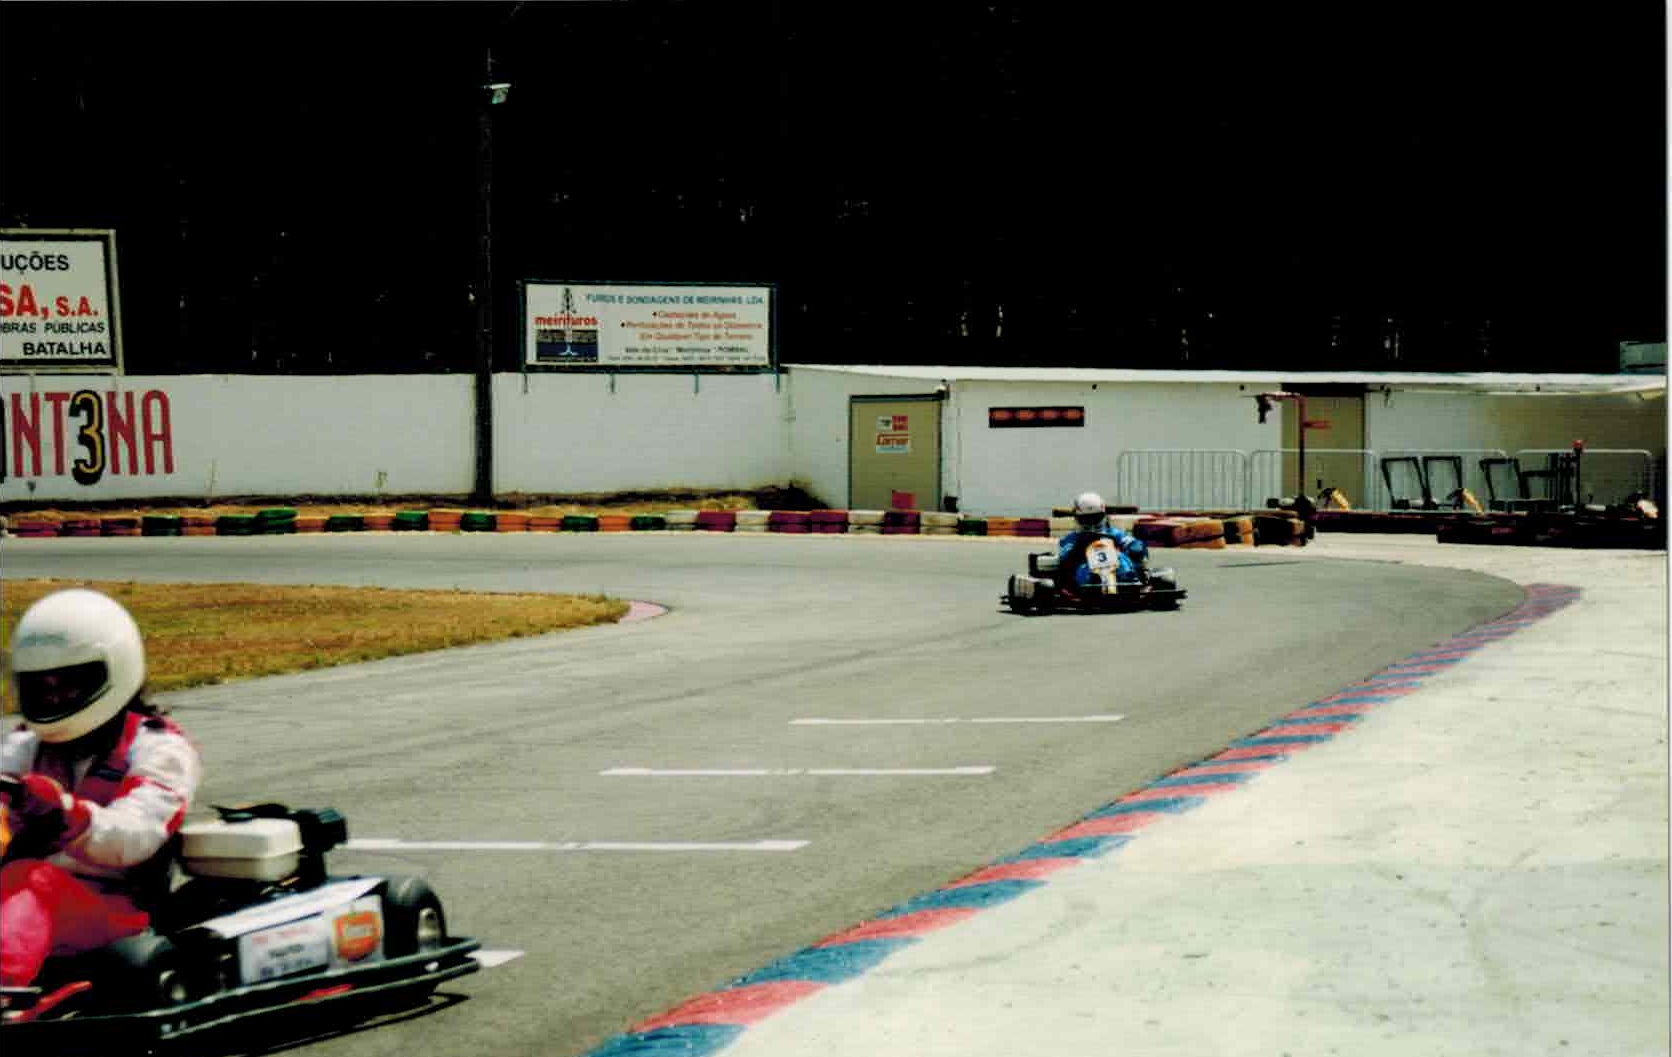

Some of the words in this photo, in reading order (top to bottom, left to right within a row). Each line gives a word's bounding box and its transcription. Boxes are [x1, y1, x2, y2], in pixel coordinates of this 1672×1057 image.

[55, 296, 99, 317] S.A.
[23, 342, 107, 356] BATALHA
[0, 389, 173, 485] NT3NA
[1098, 552, 1107, 562] 3
